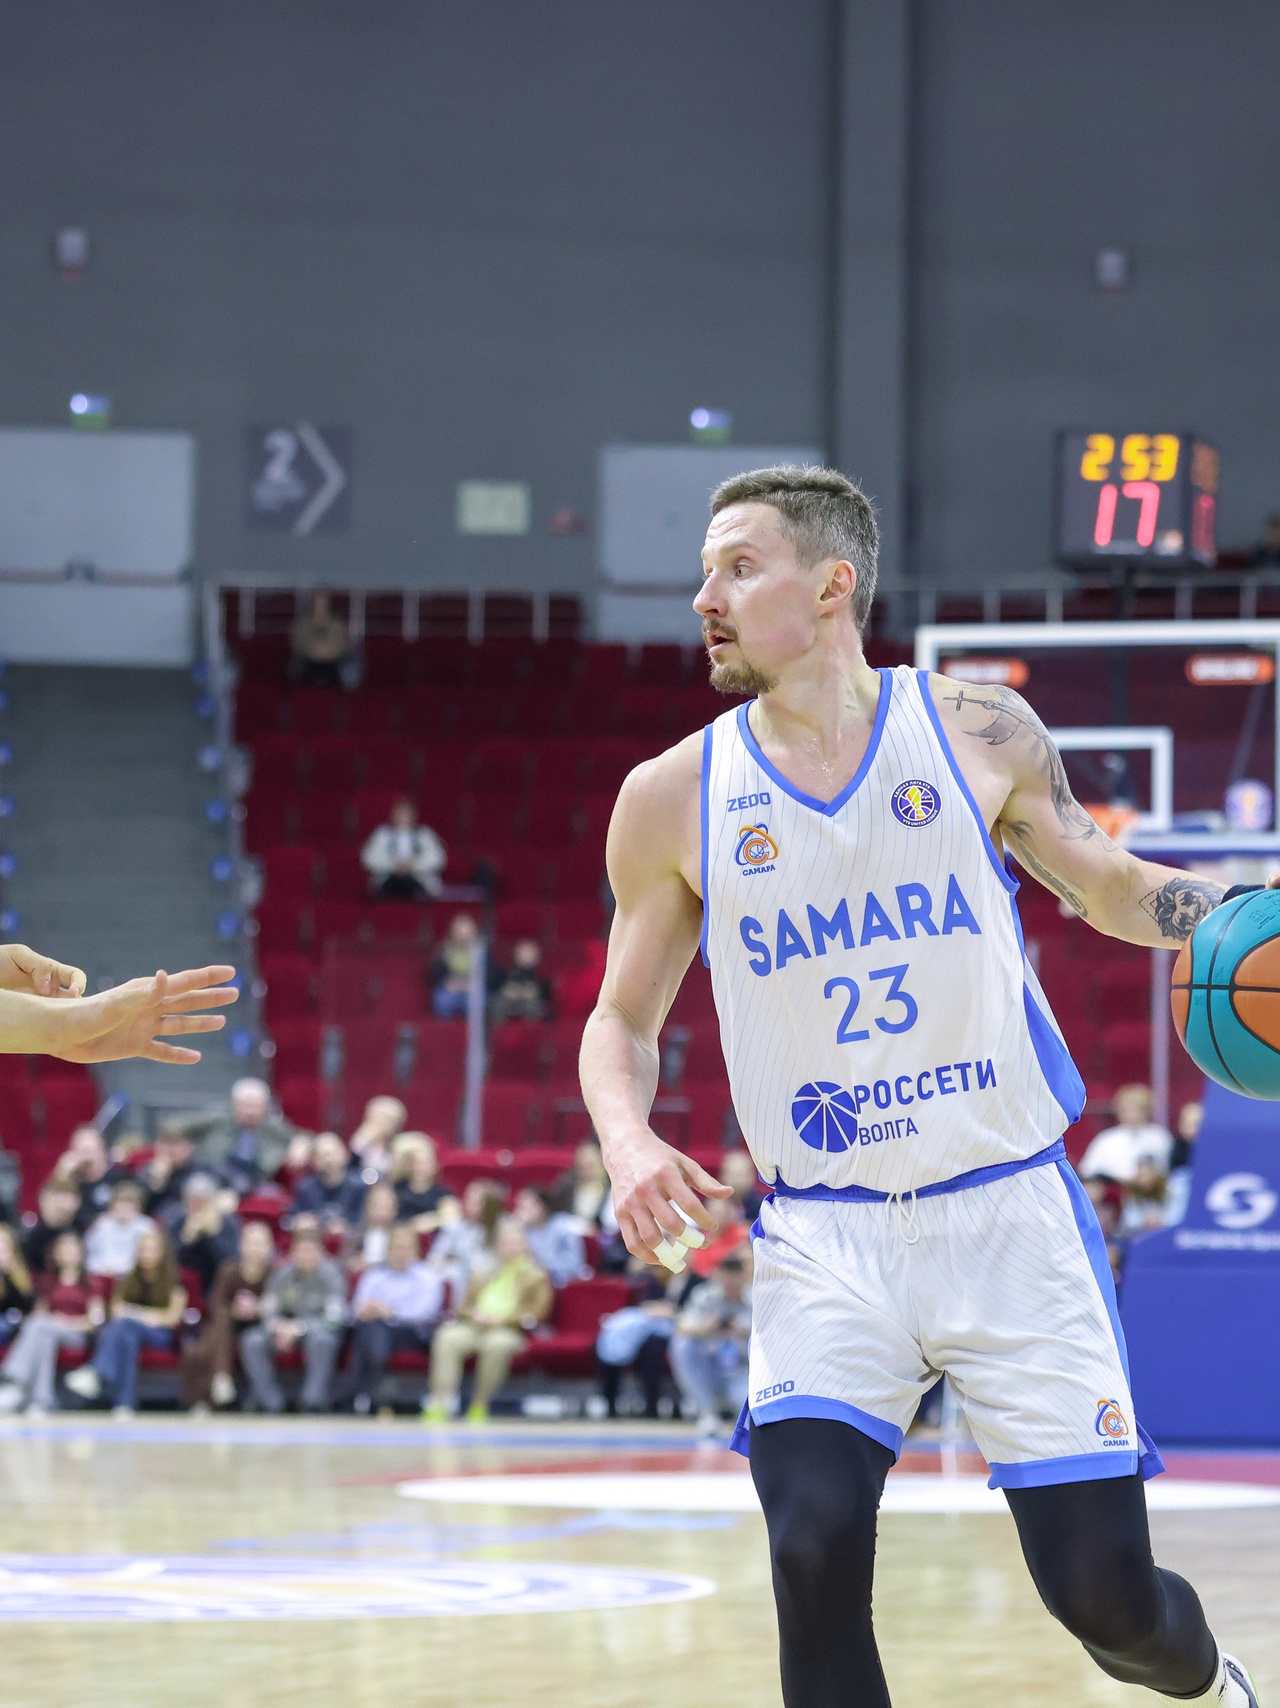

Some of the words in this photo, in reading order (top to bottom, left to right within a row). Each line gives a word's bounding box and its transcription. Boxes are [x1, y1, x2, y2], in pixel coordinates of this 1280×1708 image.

[1094, 481, 1161, 547] 17
[727, 792, 771, 812] ZEDO
[742, 864, 776, 876] САМАРА
[740, 873, 981, 977] SAMARA
[823, 964, 918, 1044] 23
[854, 1058, 997, 1115] РОССЕТИ
[858, 1117, 919, 1146] ВОЛГА
[755, 1380, 795, 1403] ZEDO
